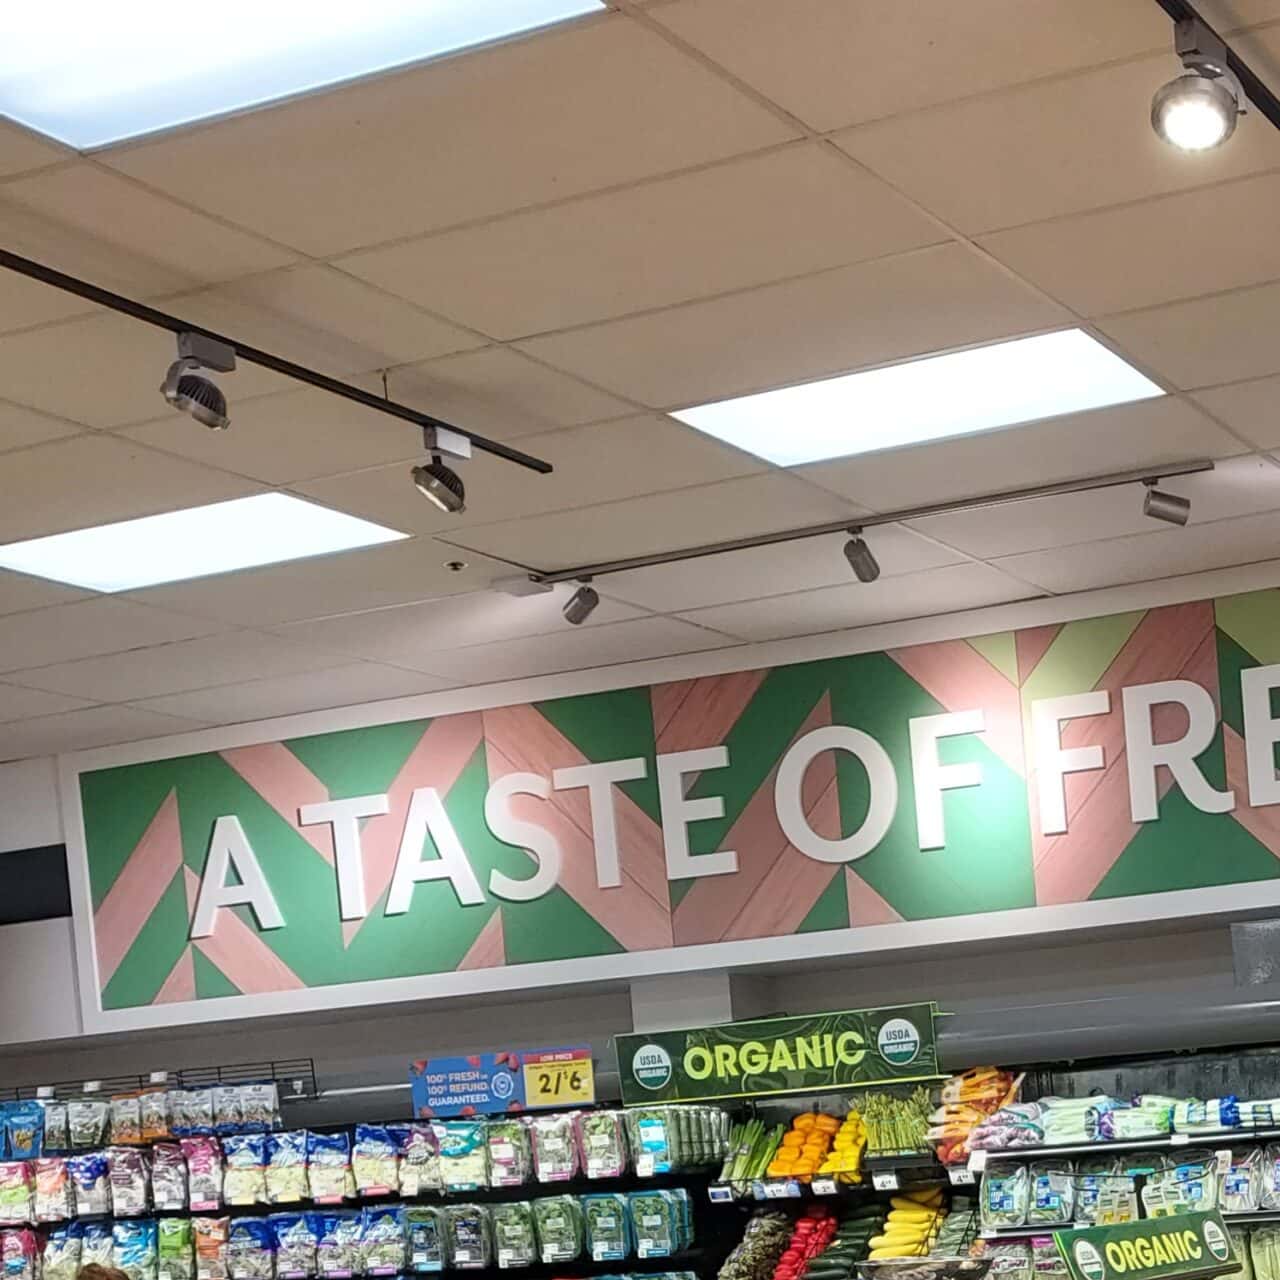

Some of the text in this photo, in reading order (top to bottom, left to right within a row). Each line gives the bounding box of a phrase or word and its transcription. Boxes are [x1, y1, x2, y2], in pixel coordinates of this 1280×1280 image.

[188, 815, 287, 940] A
[298, 745, 740, 920] TASTE
[774, 709, 985, 866] OF
[886, 1029, 910, 1041] USDA
[639, 1054, 663, 1066] USDA
[683, 1031, 865, 1080] ORGANIC
[449, 1071, 480, 1083] FRESH
[428, 1094, 490, 1106] GUARANTEED.
[1105, 1230, 1202, 1273] ORGANIC
